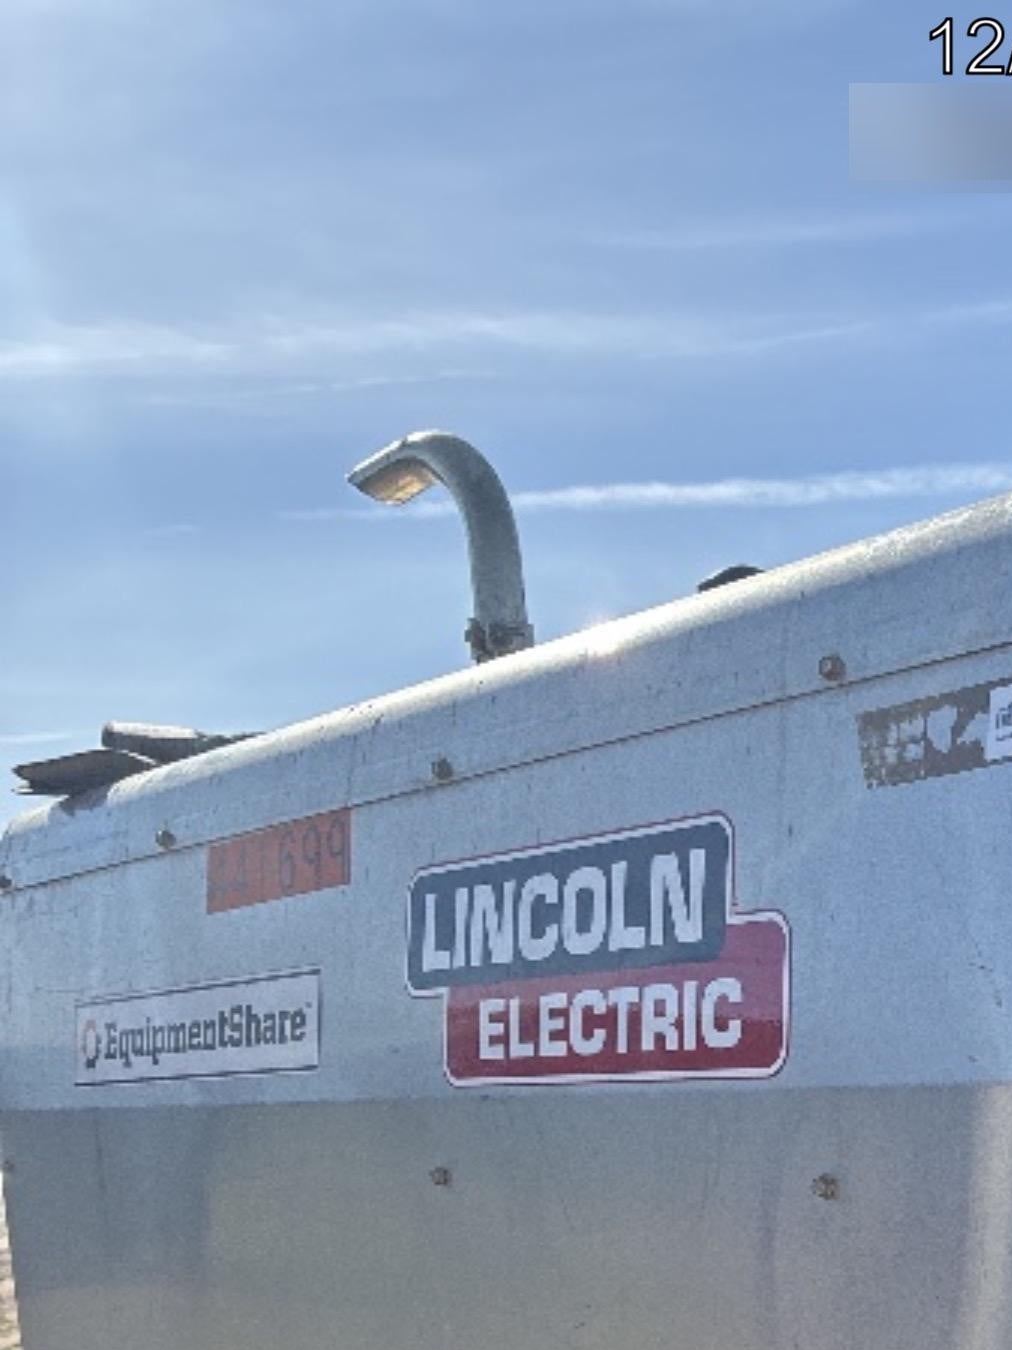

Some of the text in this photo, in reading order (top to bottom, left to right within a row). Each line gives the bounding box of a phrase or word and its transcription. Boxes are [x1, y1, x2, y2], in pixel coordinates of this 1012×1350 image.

[422, 848, 706, 972] LINCOLN
[103, 1003, 307, 1069] EquipmentShare
[478, 977, 743, 1060] ELECTRIC
